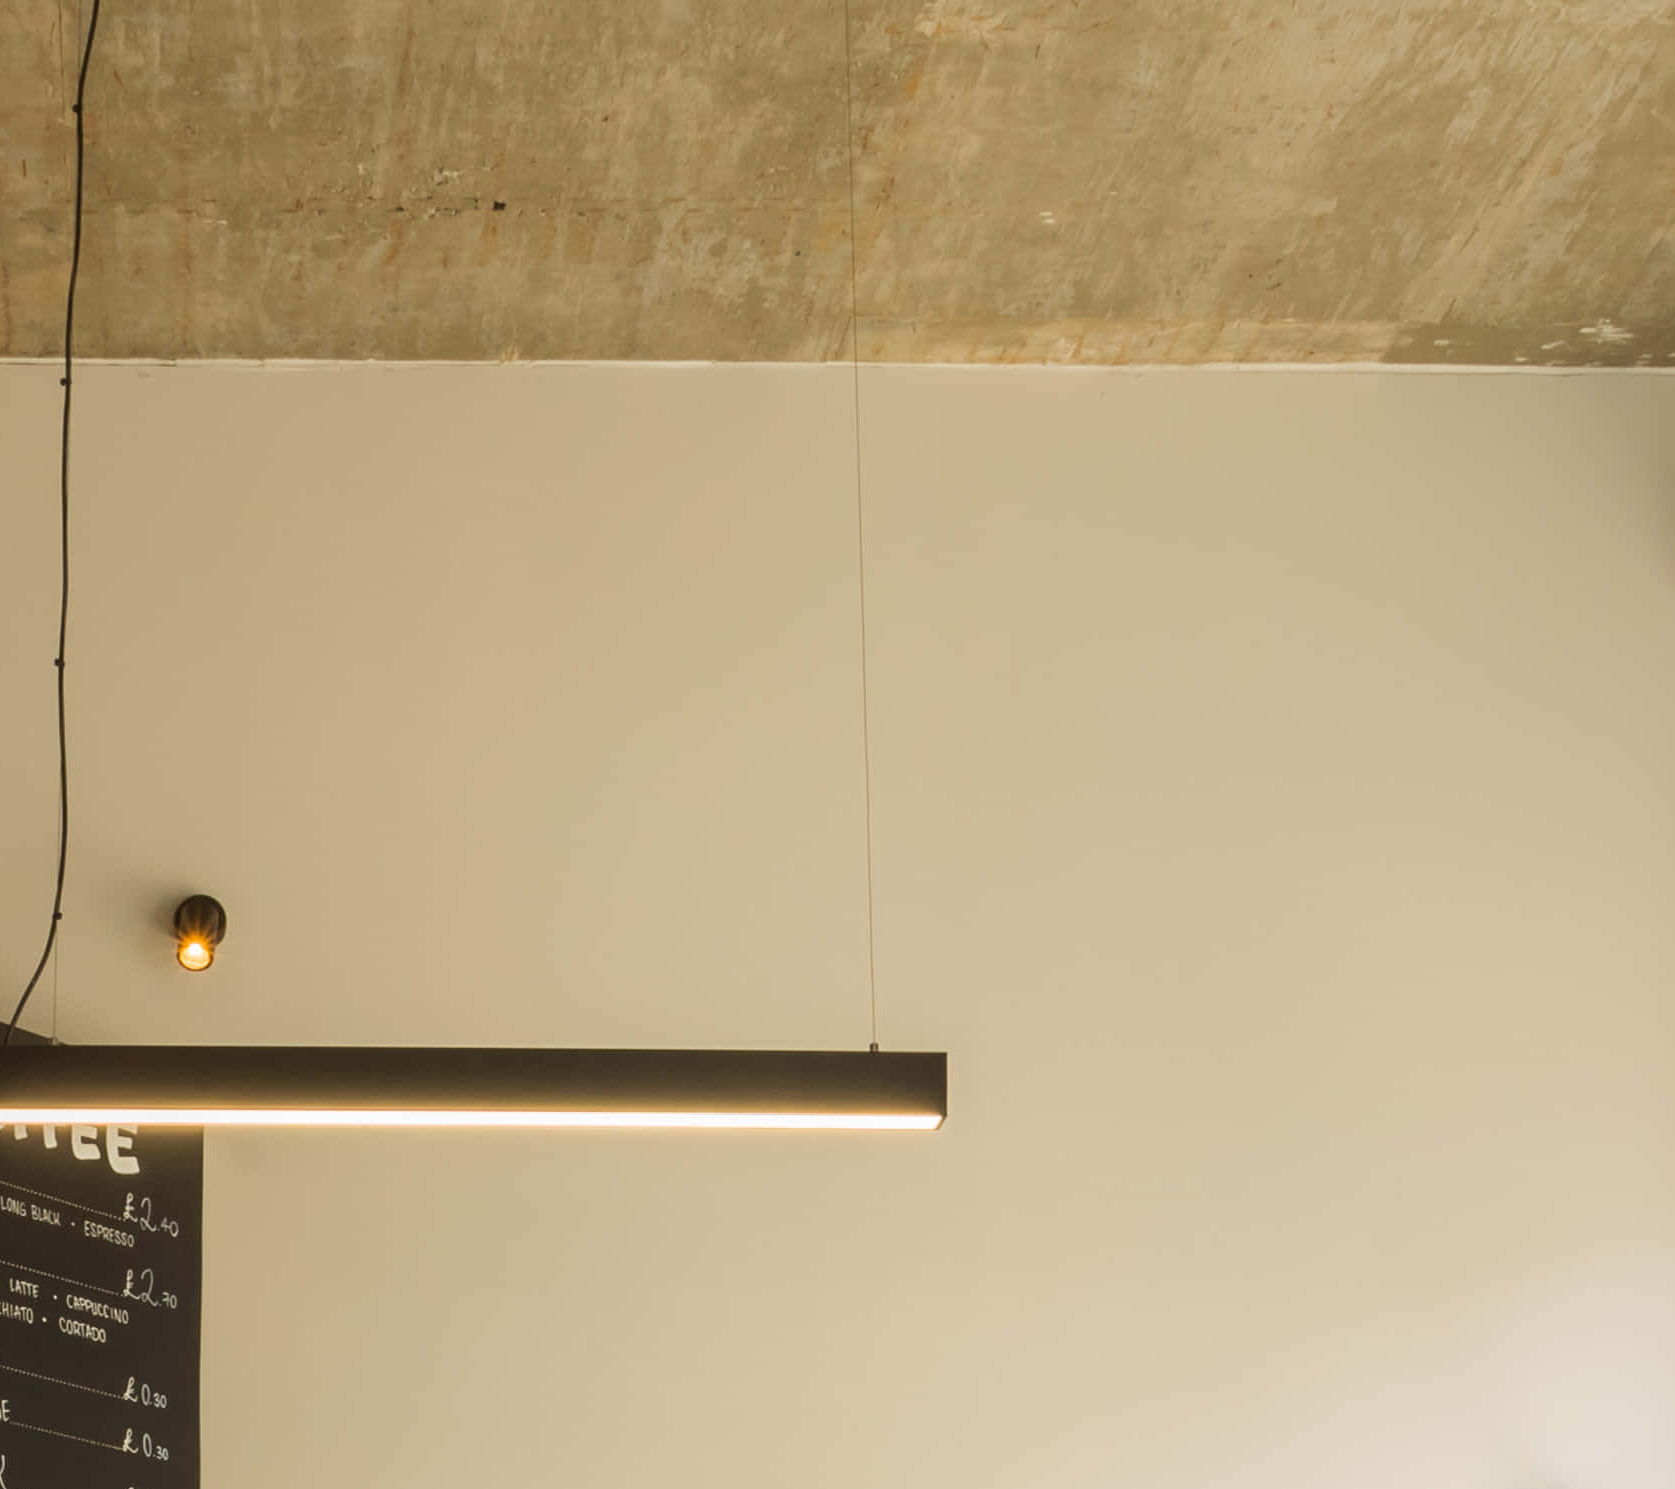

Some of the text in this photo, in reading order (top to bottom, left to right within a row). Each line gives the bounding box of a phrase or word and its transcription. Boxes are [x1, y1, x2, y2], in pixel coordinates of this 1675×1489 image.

[0, 1196, 28, 1218] LONG
[31, 1204, 62, 1227] BLACK
[83, 1220, 135, 1248] ESPRESSO
[9, 1278, 39, 1298] LATTE
[66, 1294, 130, 1325] CAPPUCCINO
[58, 1316, 107, 1344] CORTADO
